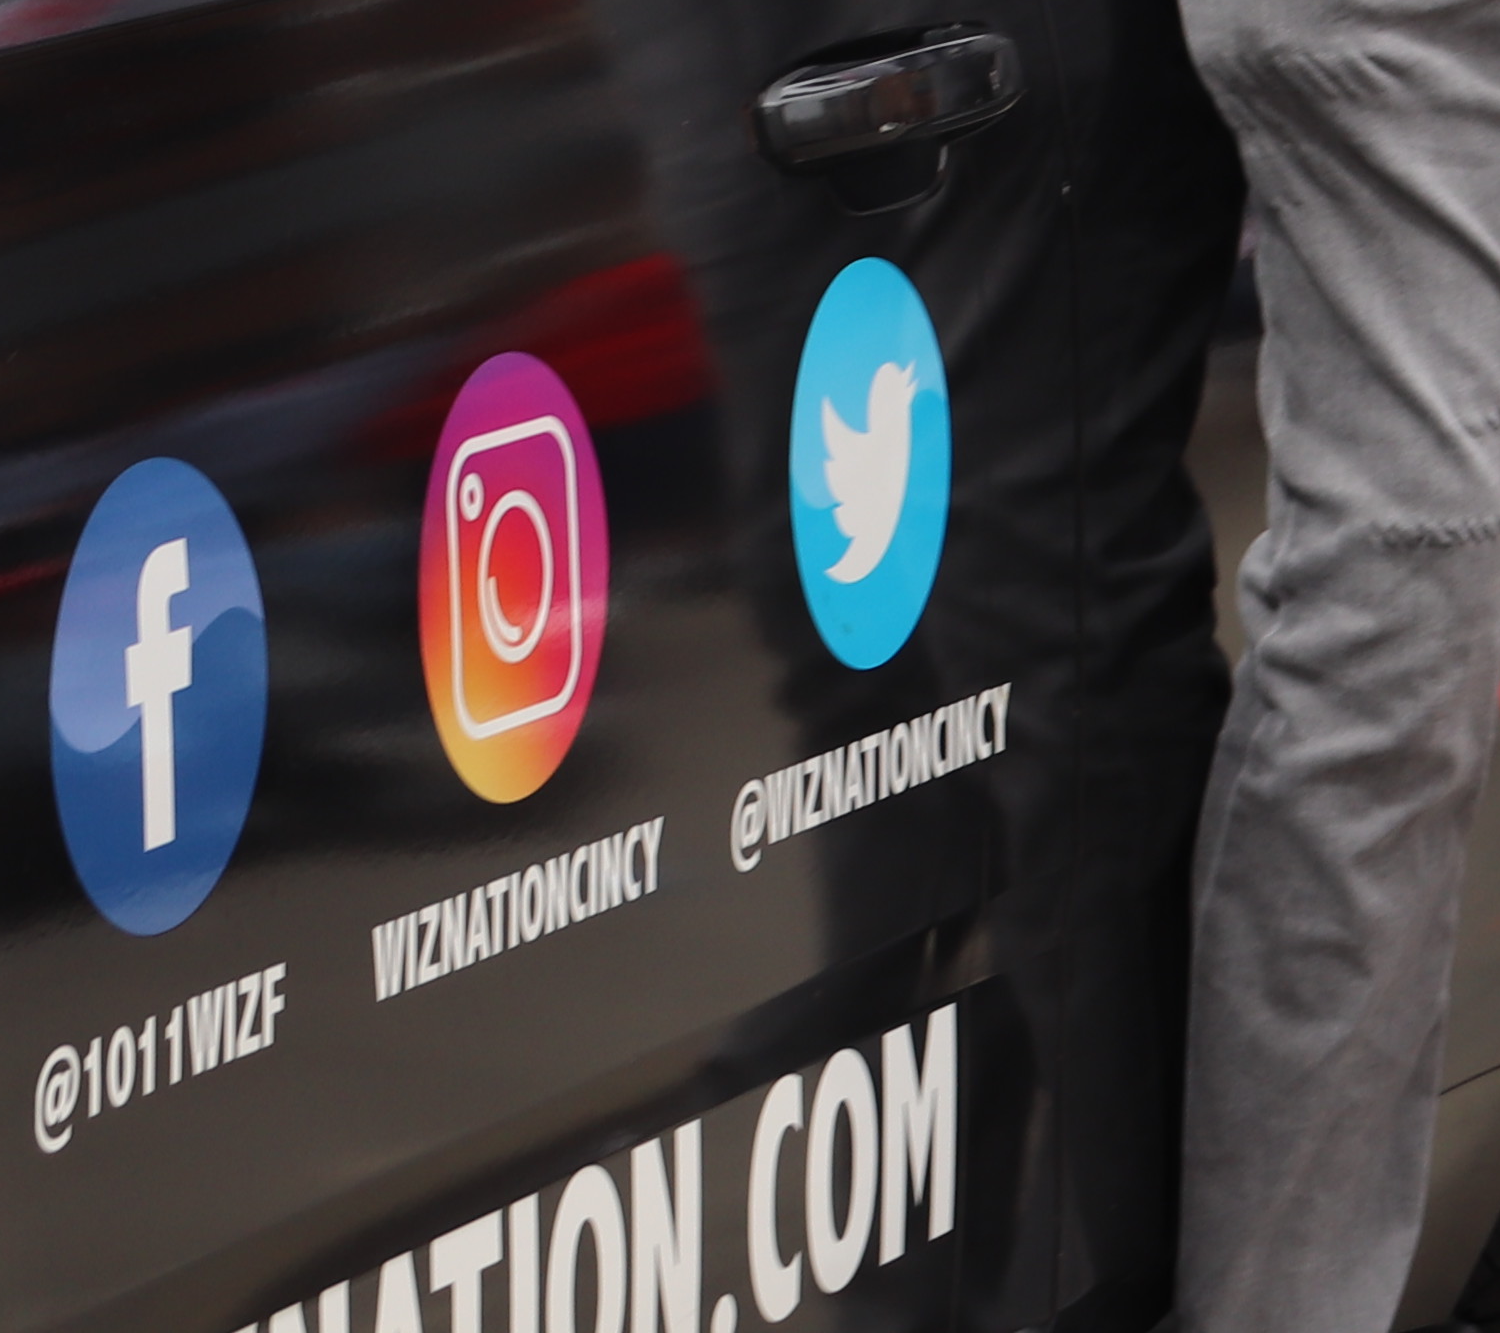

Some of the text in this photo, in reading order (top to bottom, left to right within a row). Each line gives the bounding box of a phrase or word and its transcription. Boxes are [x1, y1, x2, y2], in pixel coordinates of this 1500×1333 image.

[730, 682, 1012, 873] @WIZNATIONCINCY
[371, 816, 666, 1002] WIZNATIONCINCY
[34, 962, 287, 1154] @1011WIZF
